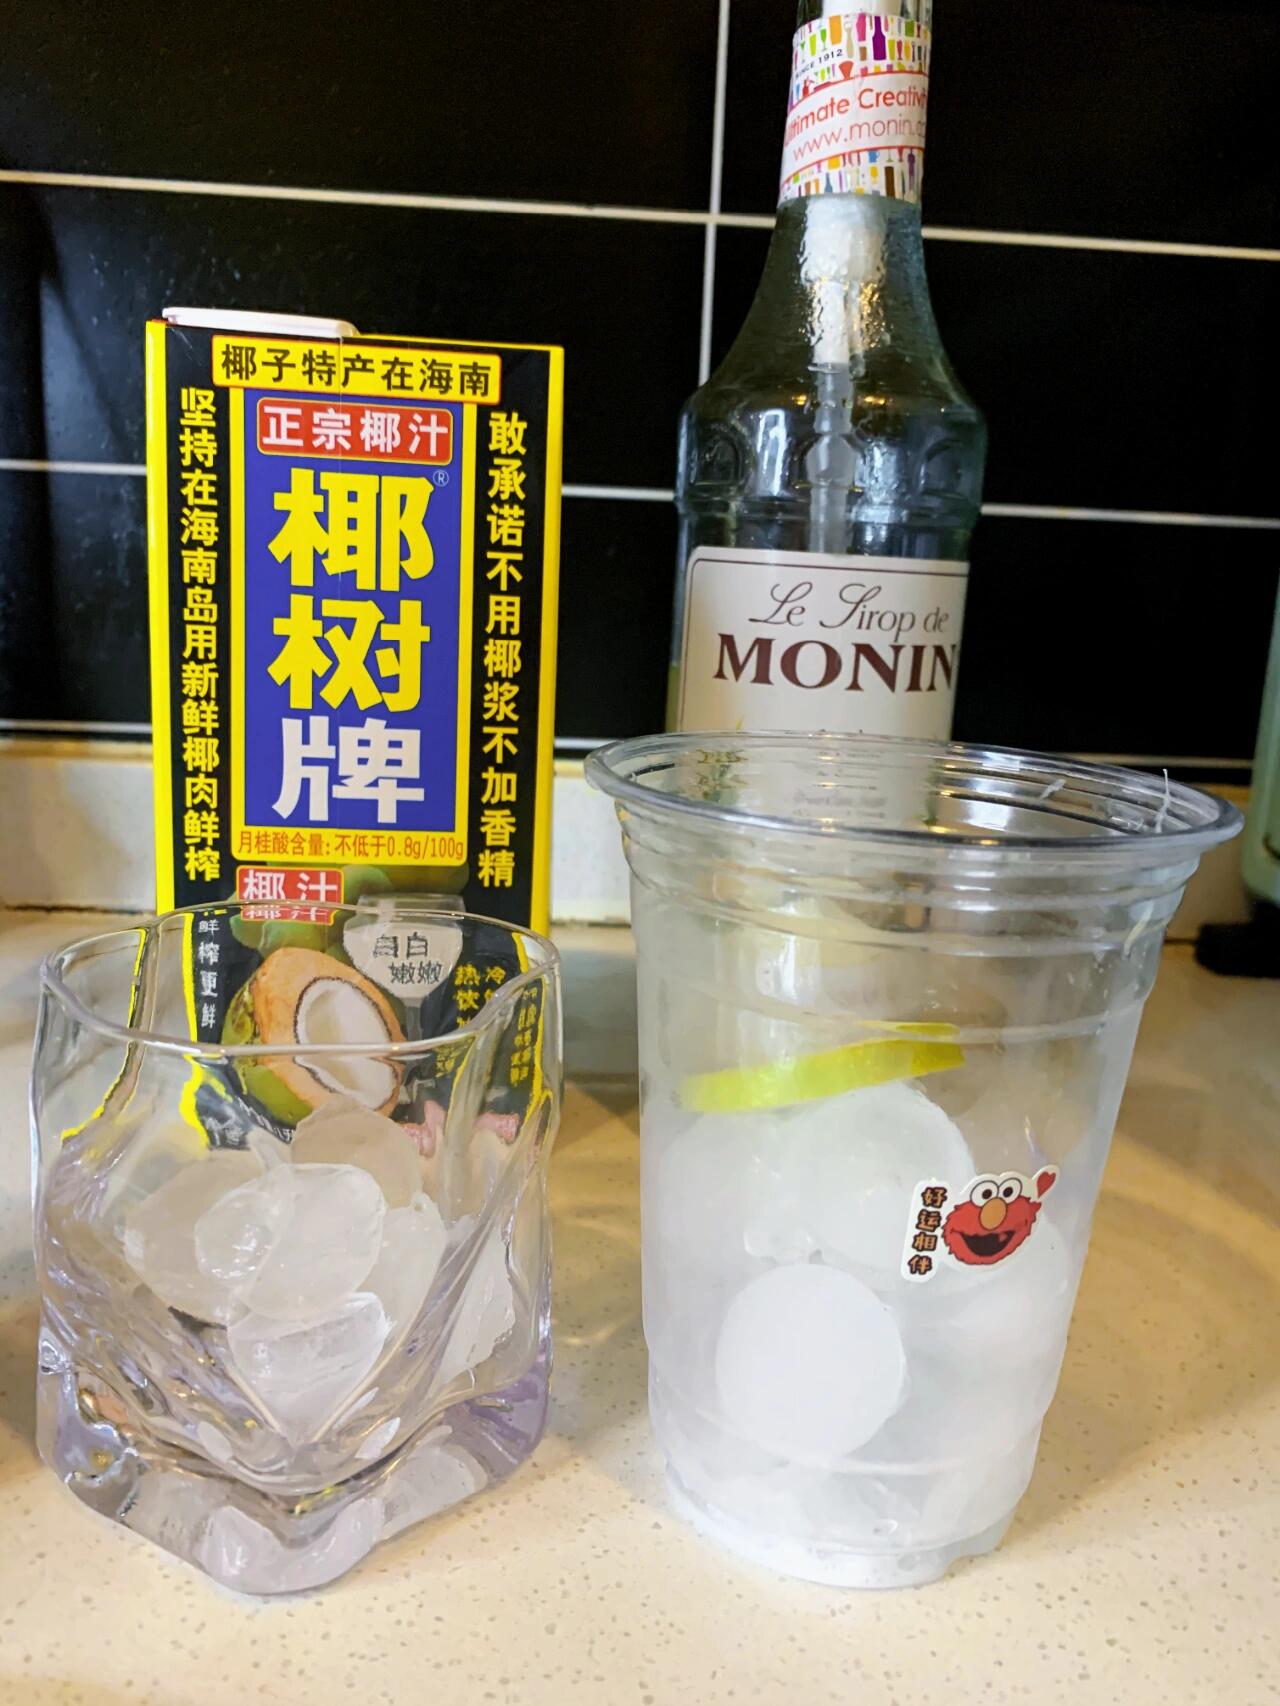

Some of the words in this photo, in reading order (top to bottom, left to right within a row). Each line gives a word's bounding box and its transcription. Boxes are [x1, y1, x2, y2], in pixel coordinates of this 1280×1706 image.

[818, 48, 843, 64] 1912
[221, 342, 491, 398] 椰子特产在海南
[262, 405, 450, 457] 正宗椰汁
[178, 386, 221, 883] 坚持在海南岛用新鲜椰肉鲜榨
[748, 581, 813, 627] Le
[818, 582, 914, 643] Sirop
[922, 605, 950, 634] de
[266, 466, 436, 825] 椰树牌
[477, 410, 528, 889] 敢承诺不用椰浆不加香精
[713, 632, 958, 693] MONIN
[242, 869, 338, 904] 椰汁
[197, 918, 221, 1029] 鲜榨更鲜
[907, 1186, 948, 1276] 好运相伴
